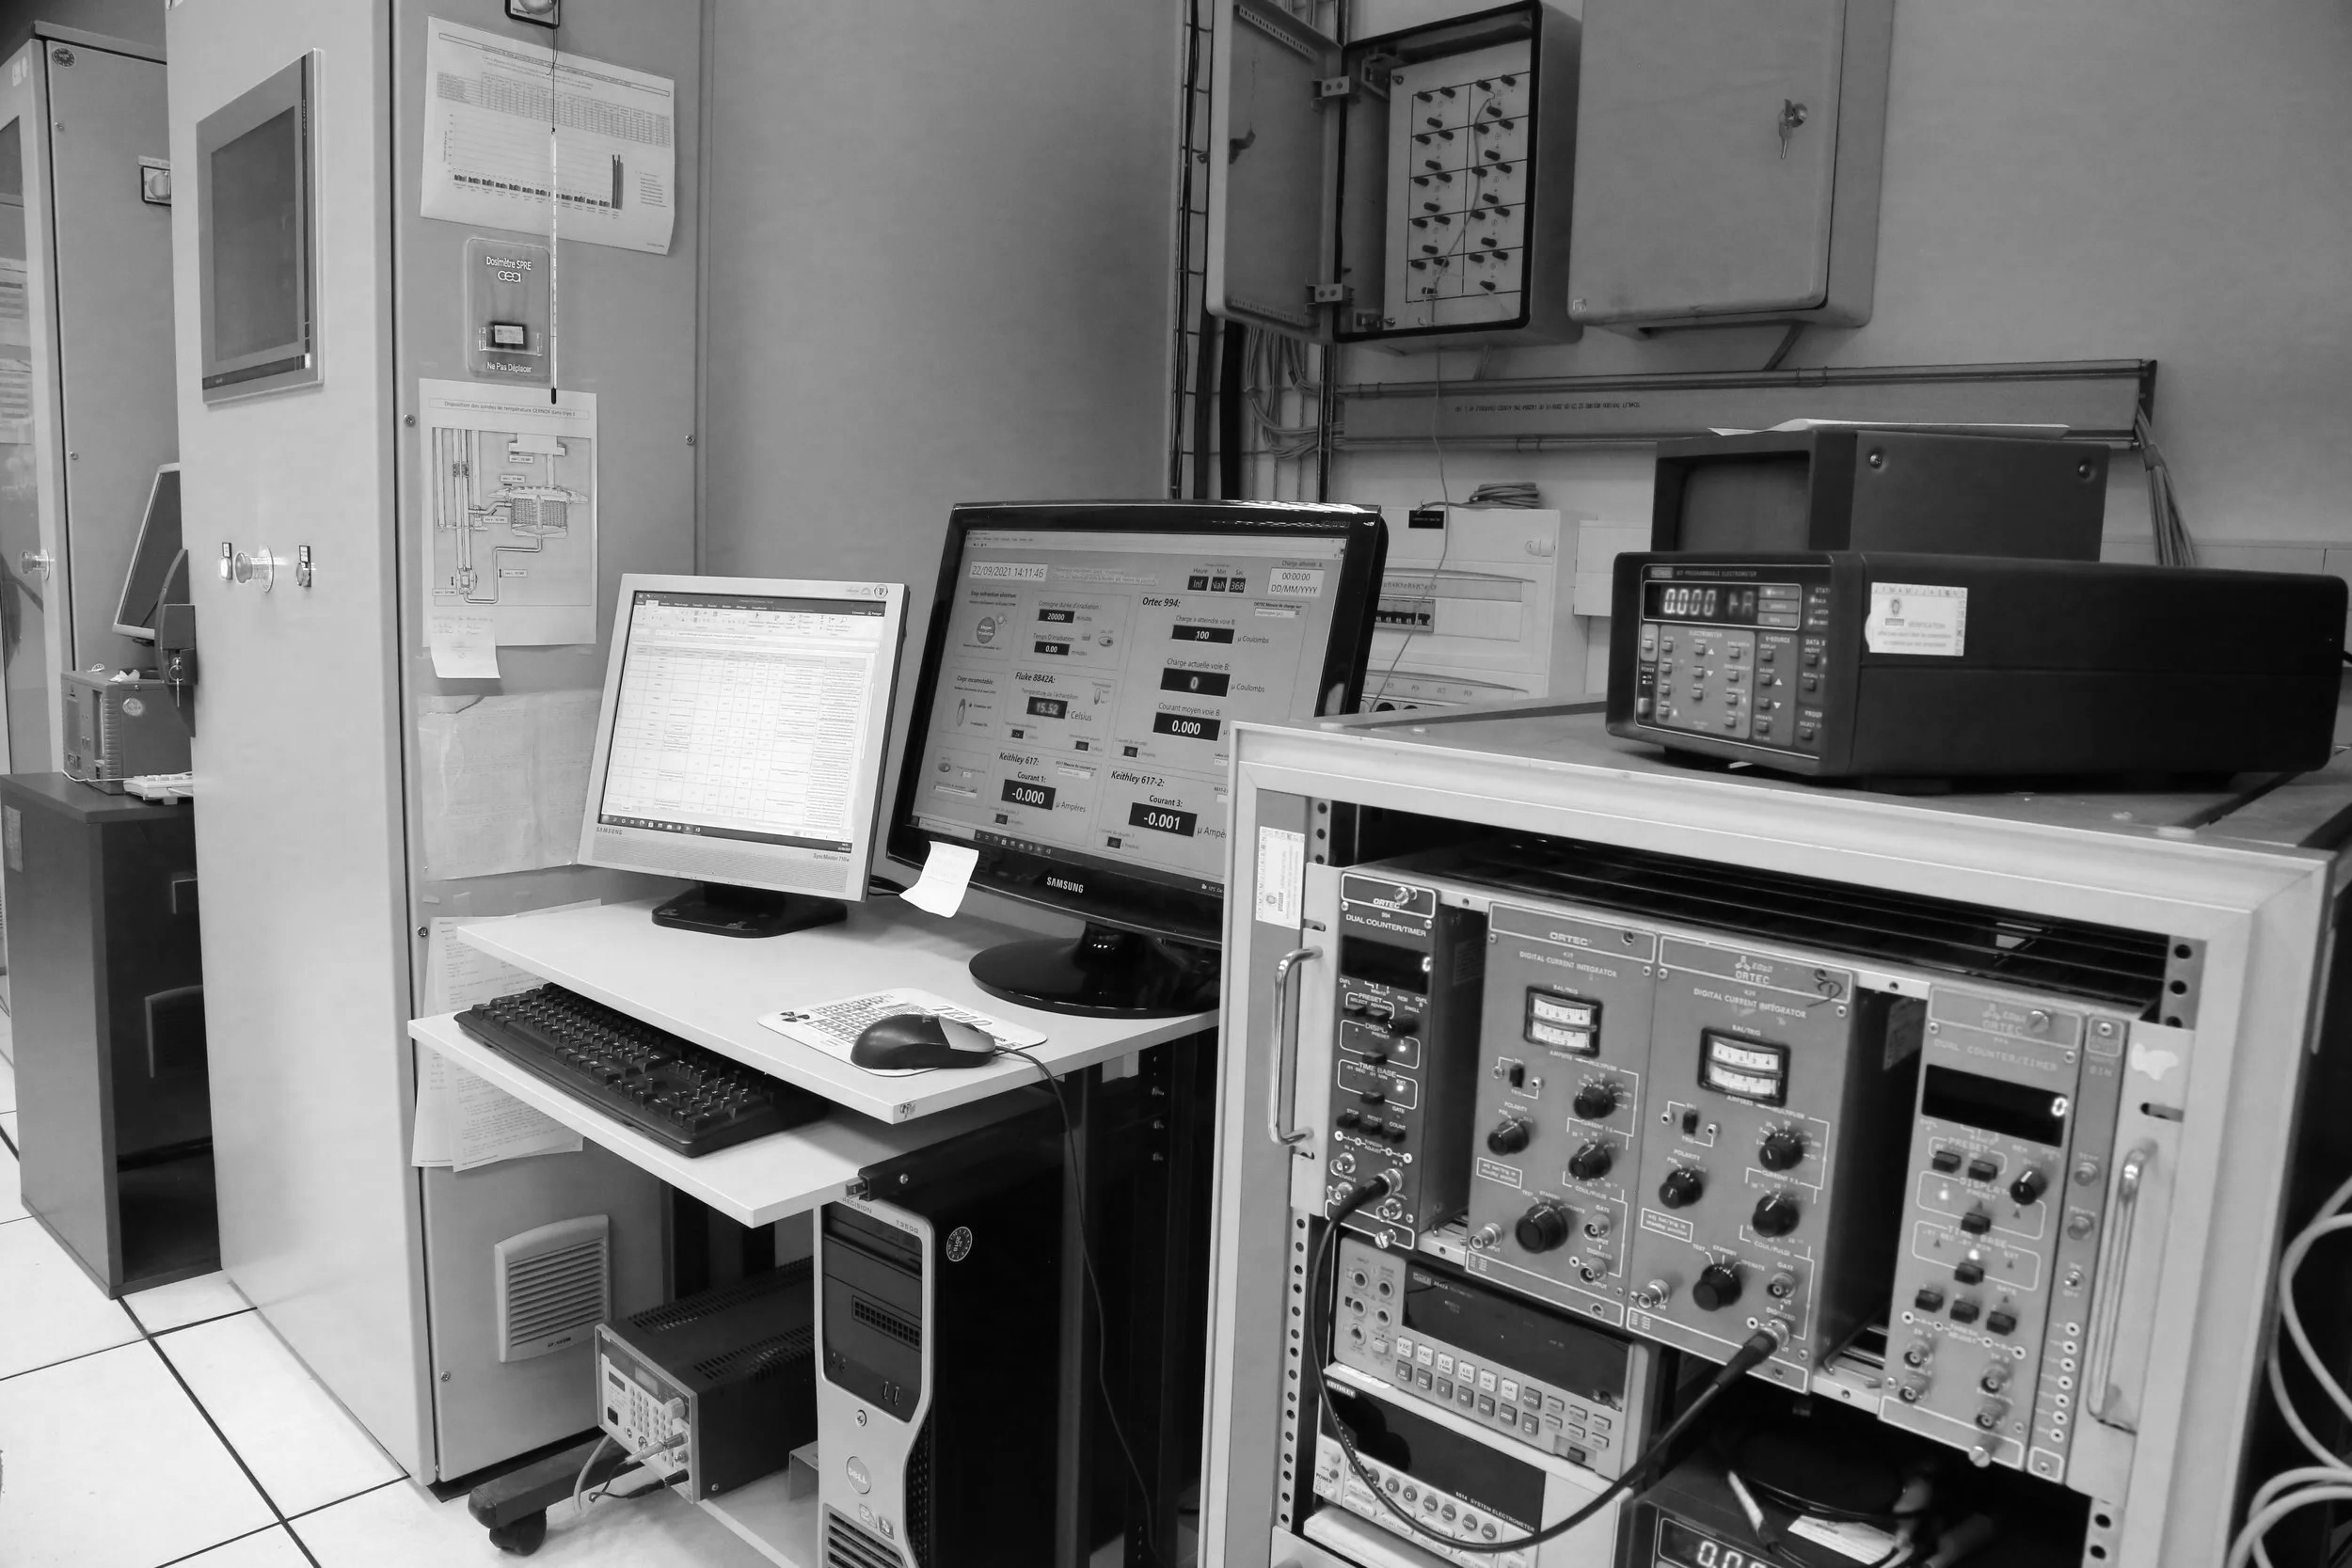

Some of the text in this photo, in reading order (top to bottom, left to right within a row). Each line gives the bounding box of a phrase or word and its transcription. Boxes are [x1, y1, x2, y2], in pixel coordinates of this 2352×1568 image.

[486, 256, 532, 271] Dosimètre SPRE
[498, 270, 521, 282] cea
[496, 362, 506, 371] Pas
[508, 363, 532, 373] Déplacer
[972, 565, 1011, 578] 22/09/2021
[1014, 567, 1043, 578] 14:11:46
[1282, 572, 1311, 581] 00:00:00
[1193, 579, 1203, 588] Inf
[1271, 584, 1317, 594] DD/MM/YYYY
[1038, 600, 1057, 610] Consigne
[1142, 596, 1181, 609] Ortec 994:
[1047, 612, 1065, 621] 20000
[1176, 615, 1192, 624] Charge
[1196, 630, 1269, 644] 100 Coulombs
[1045, 645, 1058, 654] 0.00
[1167, 657, 1186, 668] Charge
[1187, 660, 1210, 669] actuelle
[1015, 672, 1056, 684] Fluke 8842A:
[1190, 676, 1265, 693] 0 Coulombs
[1022, 688, 1046, 697] Température
[1035, 703, 1092, 721] 15.52 Celsius
[1158, 703, 1214, 716] Courant moyen voie
[1171, 720, 1201, 736] 0.000
[999, 752, 1040, 767] Keithley 617:
[1017, 771, 1046, 784] Courant 1:
[1111, 770, 1165, 788] Keithley 617-2:
[1011, 787, 1044, 805] -0.000
[1061, 802, 1087, 813] Ampères
[1149, 795, 1184, 808] Courant 3:
[1143, 812, 1181, 831] -0.001
[596, 827, 623, 835] SAMSUNG
[1046, 877, 1084, 894] SAMSUNG
[1374, 898, 1400, 910] ORTEC
[1346, 914, 1426, 937] DUAL COUNTER/TIMER
[1549, 932, 1589, 946] ORTEC
[1519, 951, 1618, 977] DIGITAL CURRENT INTEGRATOR
[1735, 971, 1771, 985] ORTEC
[1350, 997, 1392, 1011] SELECT ADVANCE
[1359, 993, 1383, 1004] PRESET
[1693, 989, 1806, 1019] DIGITAL CURRENT INTEGRATOR
[1732, 1024, 1761, 1037] BAL/TRIG
[1981, 1020, 2023, 1036] ORTEC
[1934, 1038, 2058, 1071] DUAL COUNTER/TIMER
[1359, 1062, 1397, 1078] TIME BASE
[1391, 1105, 1405, 1114] GATE
[1504, 1101, 1528, 1113] POLARITY
[2051, 1097, 2069, 1117] 0
[1367, 1114, 1383, 1123] RESET
[1389, 1121, 1406, 1131] COUNT
[1581, 1120, 1604, 1131] CURRENT
[1947, 1136, 1990, 1153] PRESET
[1674, 1149, 1700, 1161] POLARITY
[1762, 1170, 1788, 1181] CURRENT
[843, 1197, 919, 1233] RECISION T3500
[1596, 1205, 1611, 1213] GATE
[1692, 1243, 1706, 1252] TEST
[1980, 1234, 2008, 1249] BASE
[1712, 1244, 1737, 1257] STANDBY
[1777, 1261, 1794, 1271] GATE
[1523, 1395, 1538, 1405] AUTO
[1501, 1411, 1513, 1421] 2000
[849, 1467, 866, 1484] DELL
[1316, 1472, 1333, 1484] POWER
[1470, 1497, 1491, 1513] SYSTEM
[1492, 1507, 1535, 1533] ELECTROMETER
